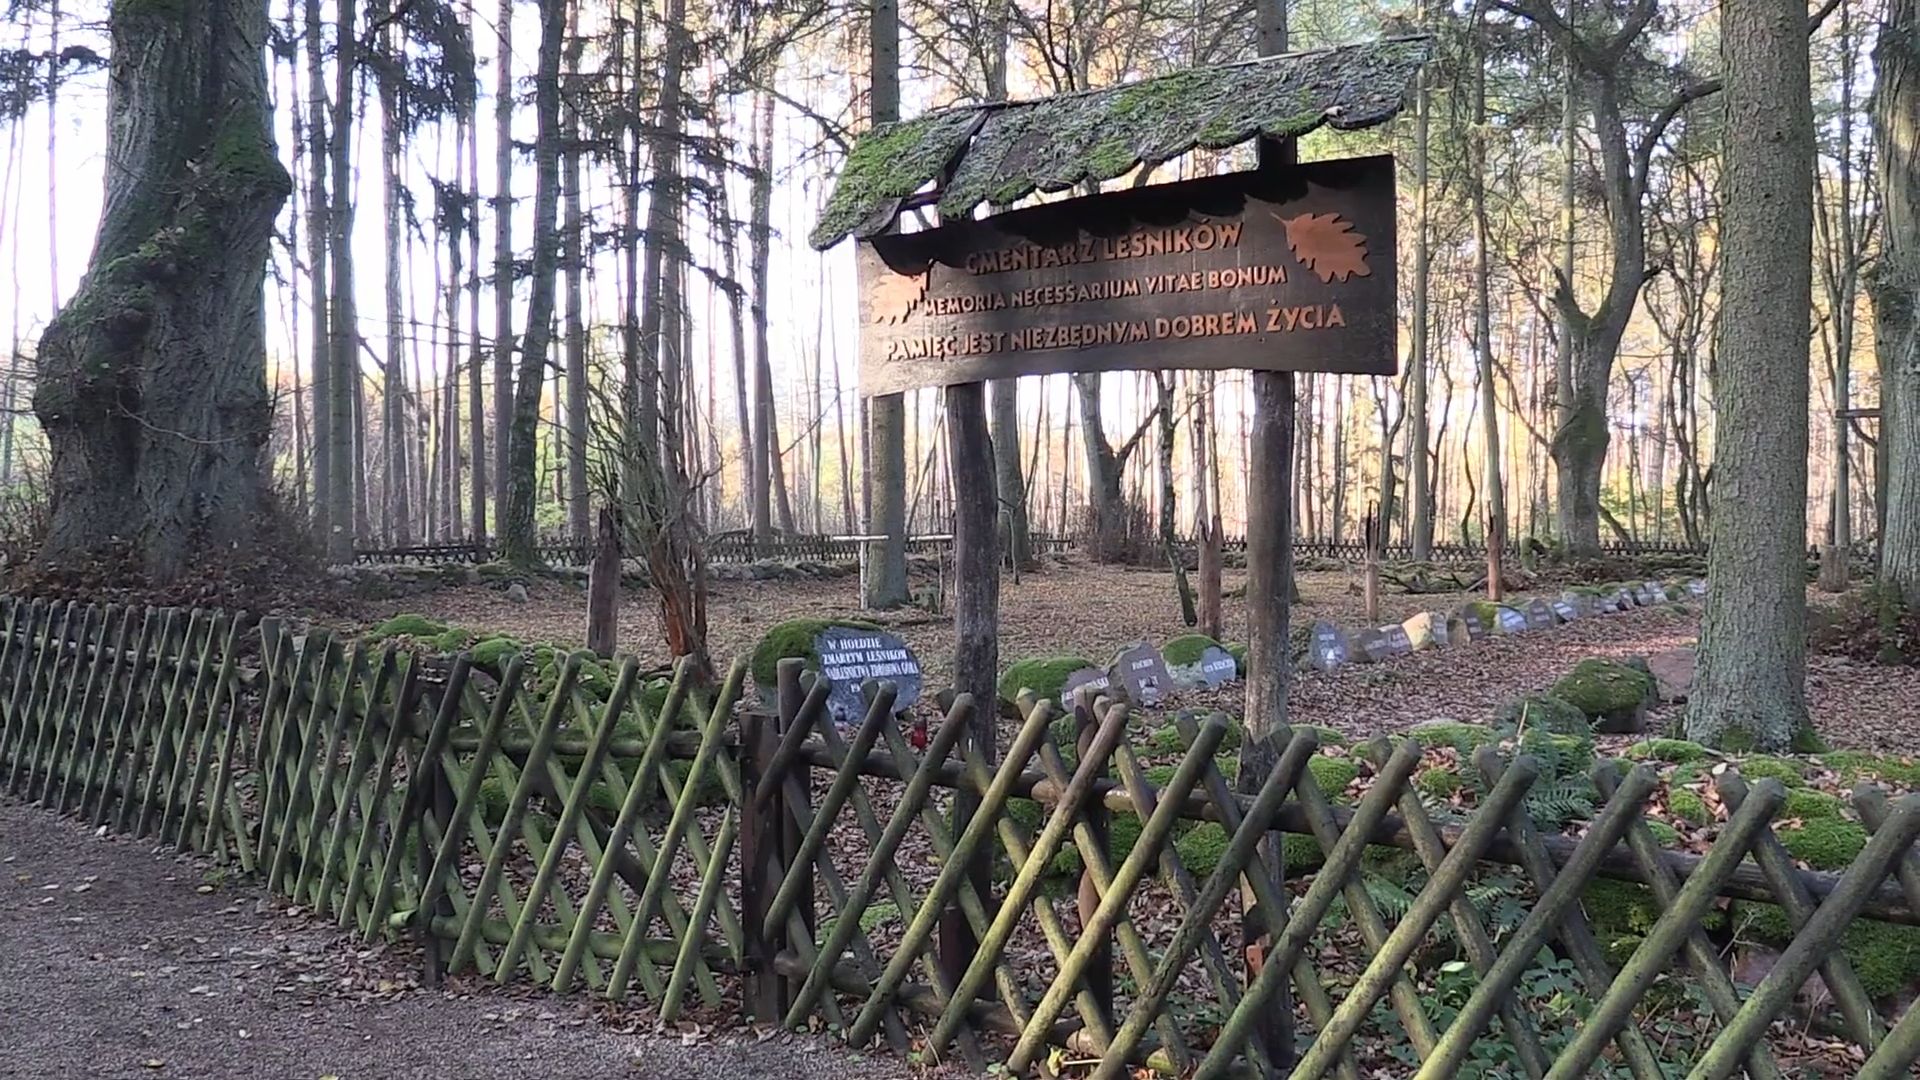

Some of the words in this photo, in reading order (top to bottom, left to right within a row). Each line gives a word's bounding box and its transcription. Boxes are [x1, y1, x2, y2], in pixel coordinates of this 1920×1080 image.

[966, 239, 1095, 276] CMENTARZ
[1103, 219, 1244, 261] LEŚNIKÓW
[923, 293, 1008, 317] MEMORIA
[1012, 280, 1141, 309] NECESSARIUM
[1145, 272, 1204, 295] VITAE
[1208, 265, 1288, 289] BONUM
[887, 326, 958, 362] PAMIĘĆ
[961, 332, 1008, 356] JEST
[1011, 321, 1149, 352] NIEZBĘDNYM
[1154, 311, 1258, 338] DOBREM
[1266, 299, 1346, 332] ŻYCIA
[827, 640, 837, 650] W
